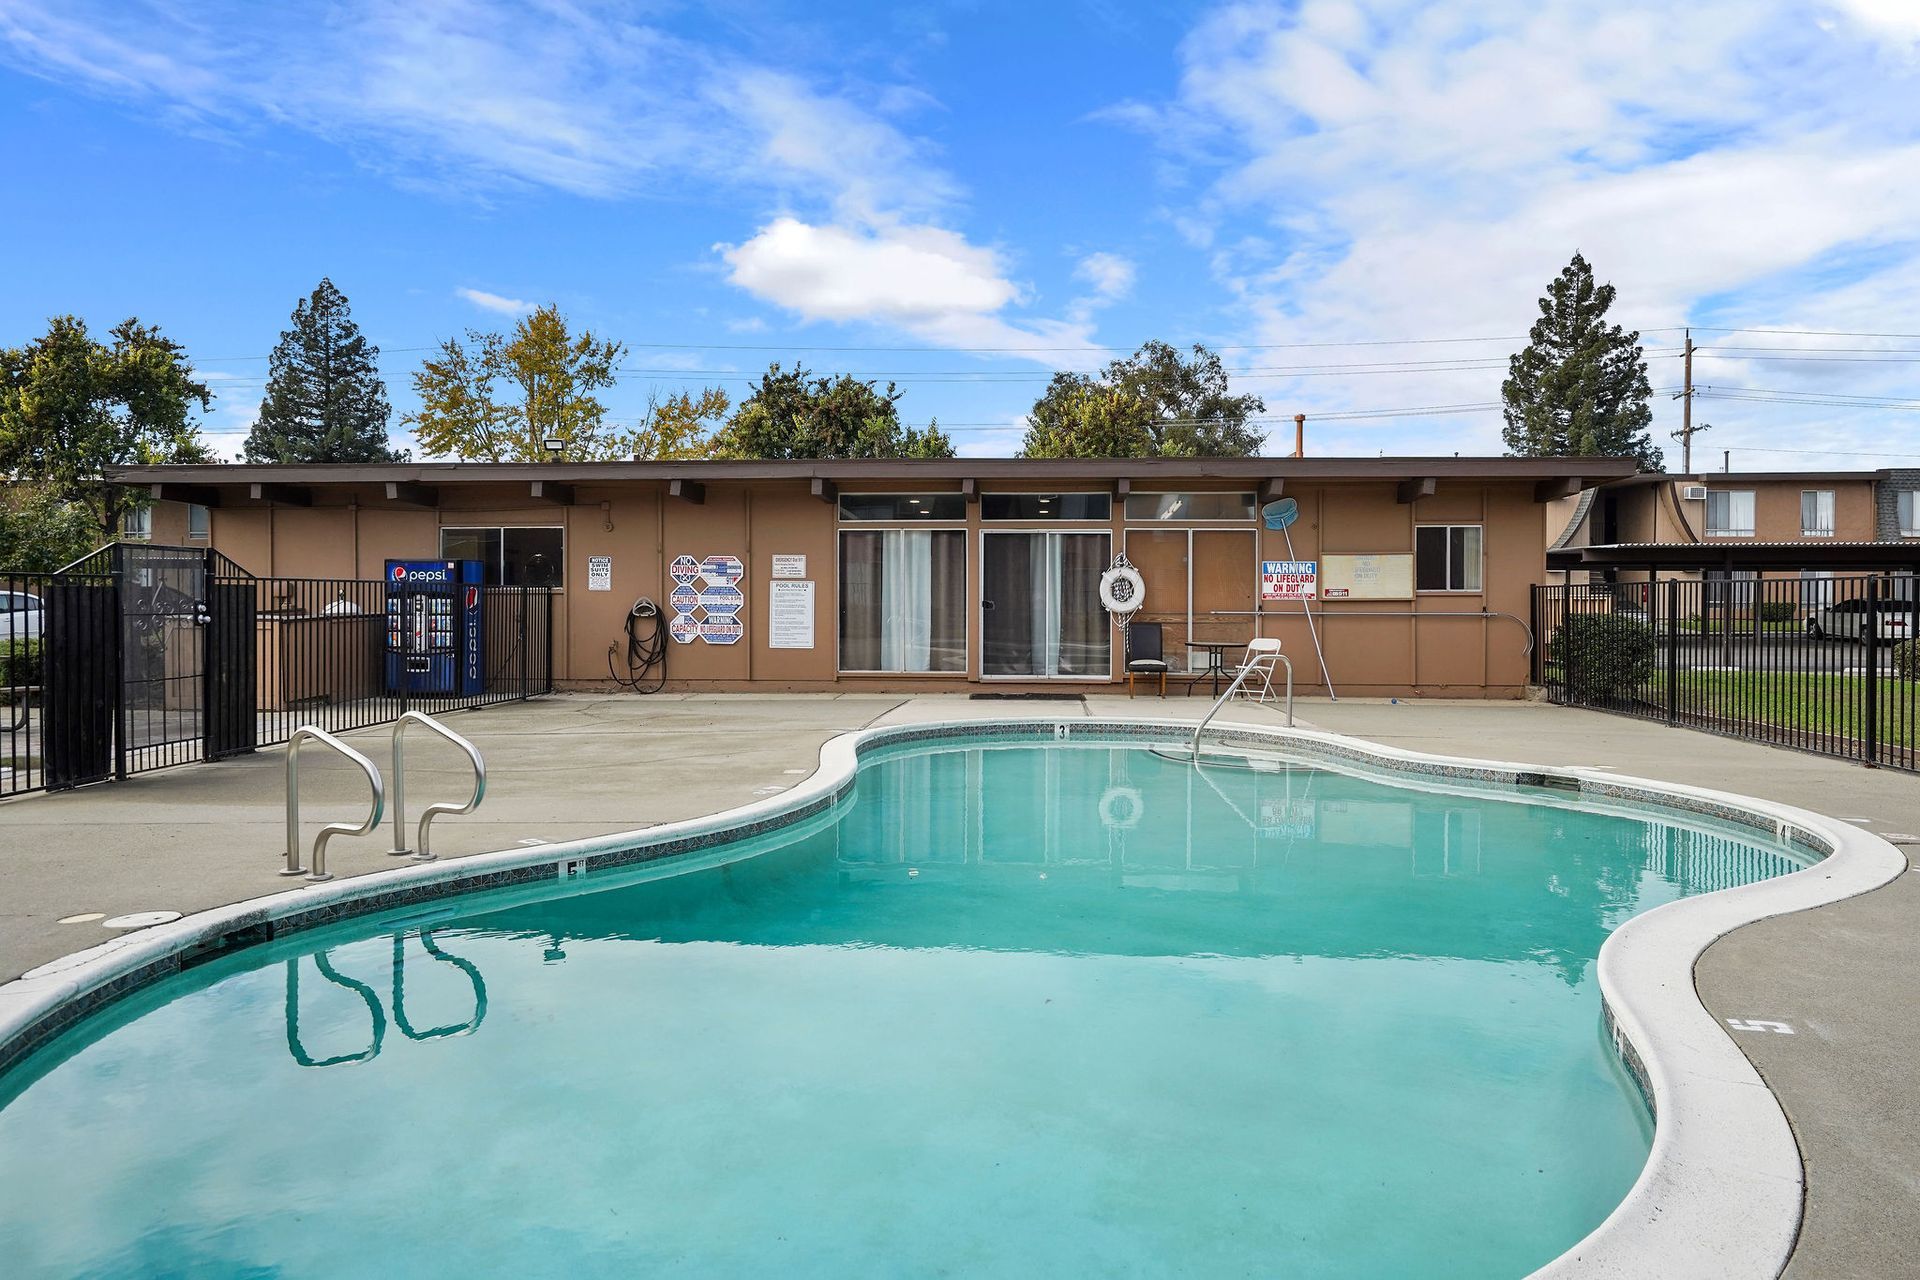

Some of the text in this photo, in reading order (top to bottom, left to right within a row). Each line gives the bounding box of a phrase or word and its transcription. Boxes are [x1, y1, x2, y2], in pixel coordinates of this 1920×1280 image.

[680, 556, 691, 566] NO
[671, 565, 699, 574] DIVING
[1266, 563, 1313, 574] WARNING
[409, 569, 445, 583] pepsi
[1263, 574, 1315, 583] NO LIFEGUARD
[1273, 583, 1284, 593] ON
[671, 595, 698, 604] CAUTION
[708, 615, 734, 625] WARNING
[671, 624, 698, 633] CAPACITY
[567, 861, 577, 876] 5
